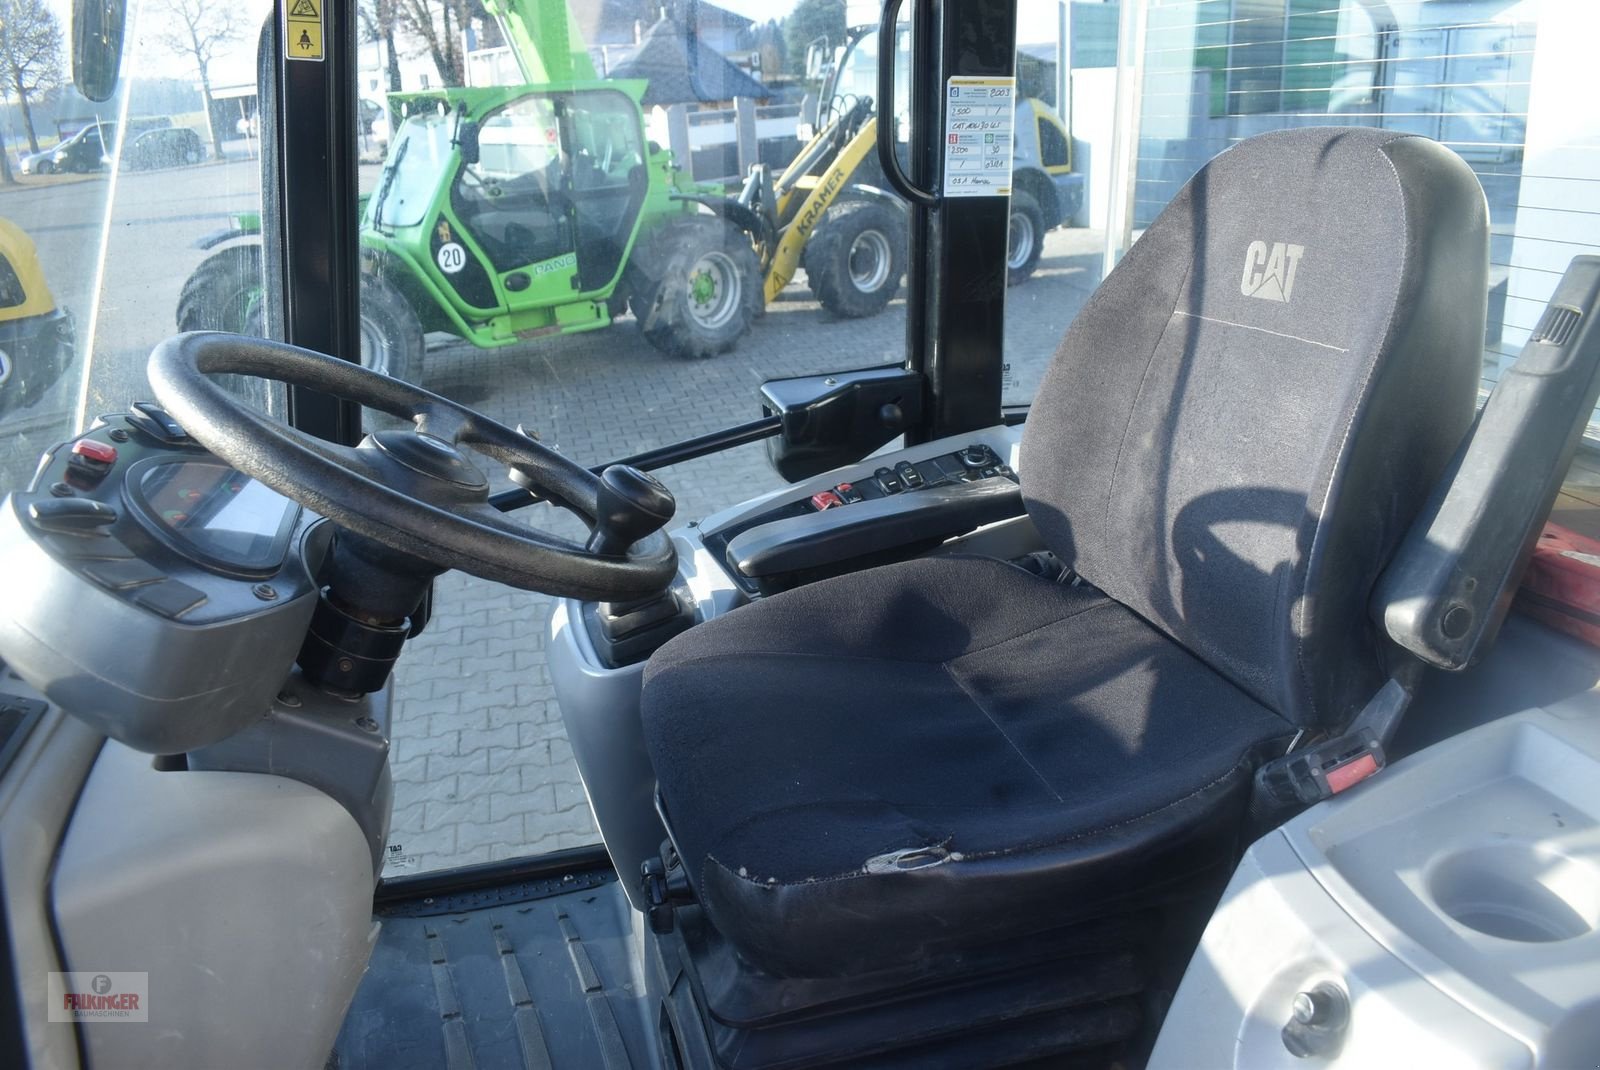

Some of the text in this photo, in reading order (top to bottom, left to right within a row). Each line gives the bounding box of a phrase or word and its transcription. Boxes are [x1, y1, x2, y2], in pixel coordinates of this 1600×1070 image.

[797, 168, 844, 235] KRAMER
[442, 248, 461, 268] 20
[1240, 240, 1305, 304] CAT
